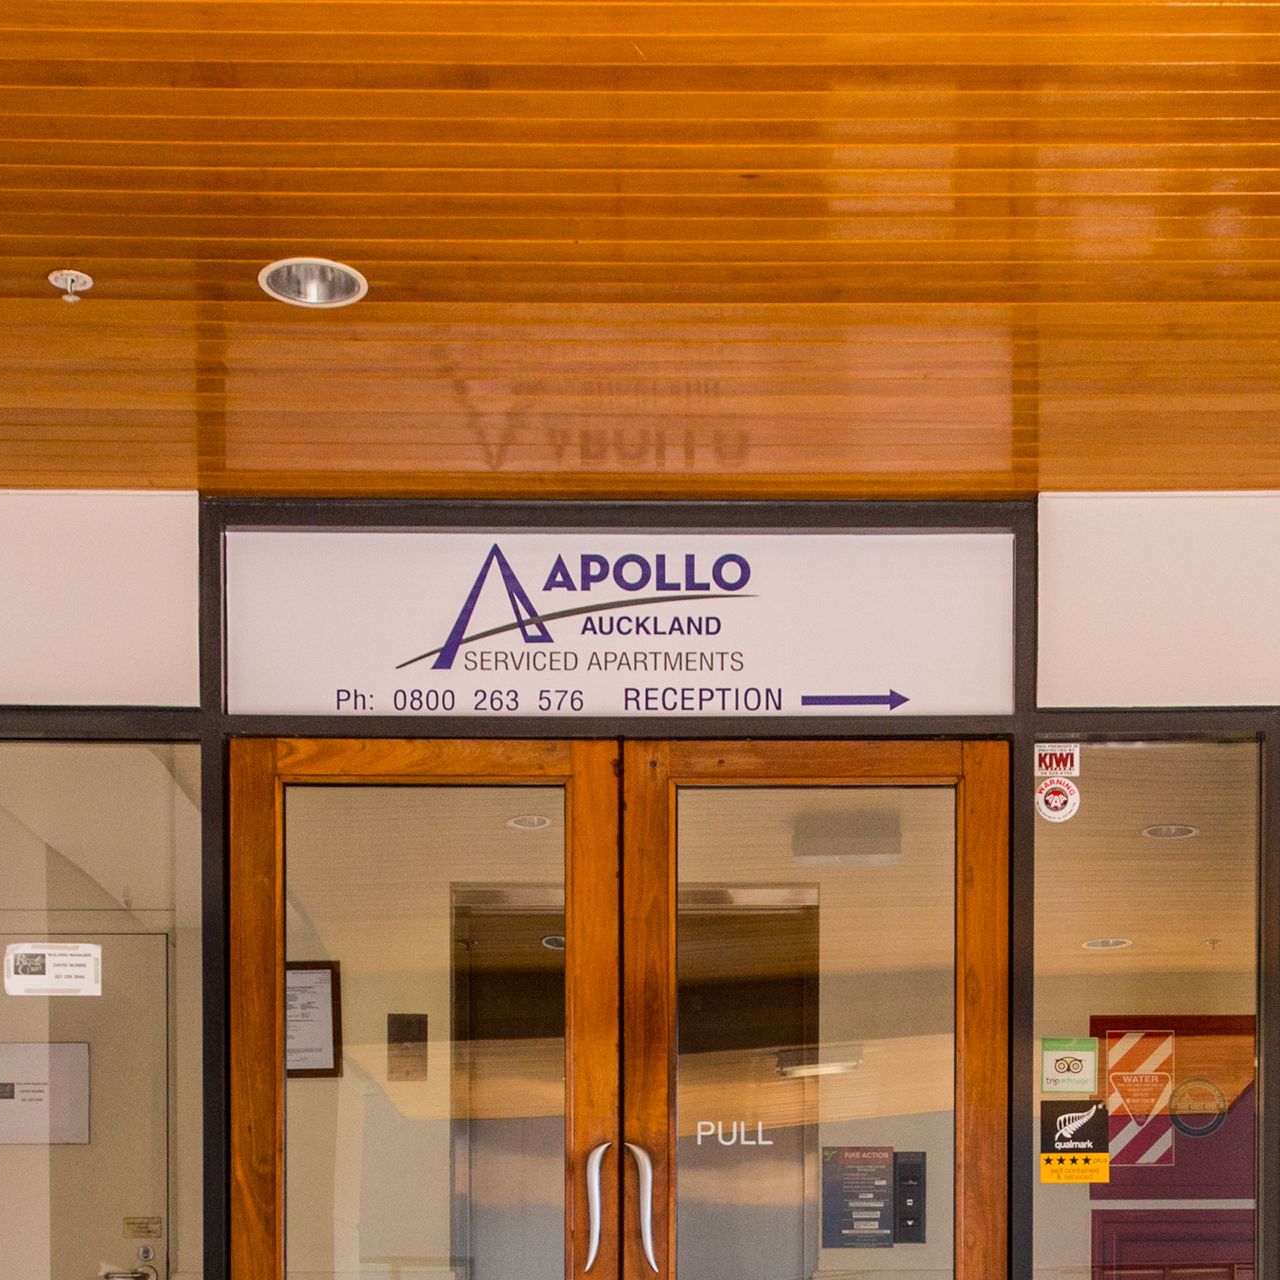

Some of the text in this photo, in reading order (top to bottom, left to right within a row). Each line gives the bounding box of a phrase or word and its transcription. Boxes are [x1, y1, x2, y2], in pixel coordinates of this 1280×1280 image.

[542, 553, 751, 592] APOLLO
[581, 616, 722, 636] AUCKLAND
[464, 650, 744, 672] SERVICED APARTMENTS
[336, 687, 783, 711] Ph: 0800 263 576 RECEPTION
[1038, 752, 1074, 771] KIWI
[1037, 779, 1076, 796] WARNING
[1122, 1075, 1159, 1083] WATER
[696, 1121, 774, 1146] PULL
[1054, 1140, 1093, 1150] qualmark
